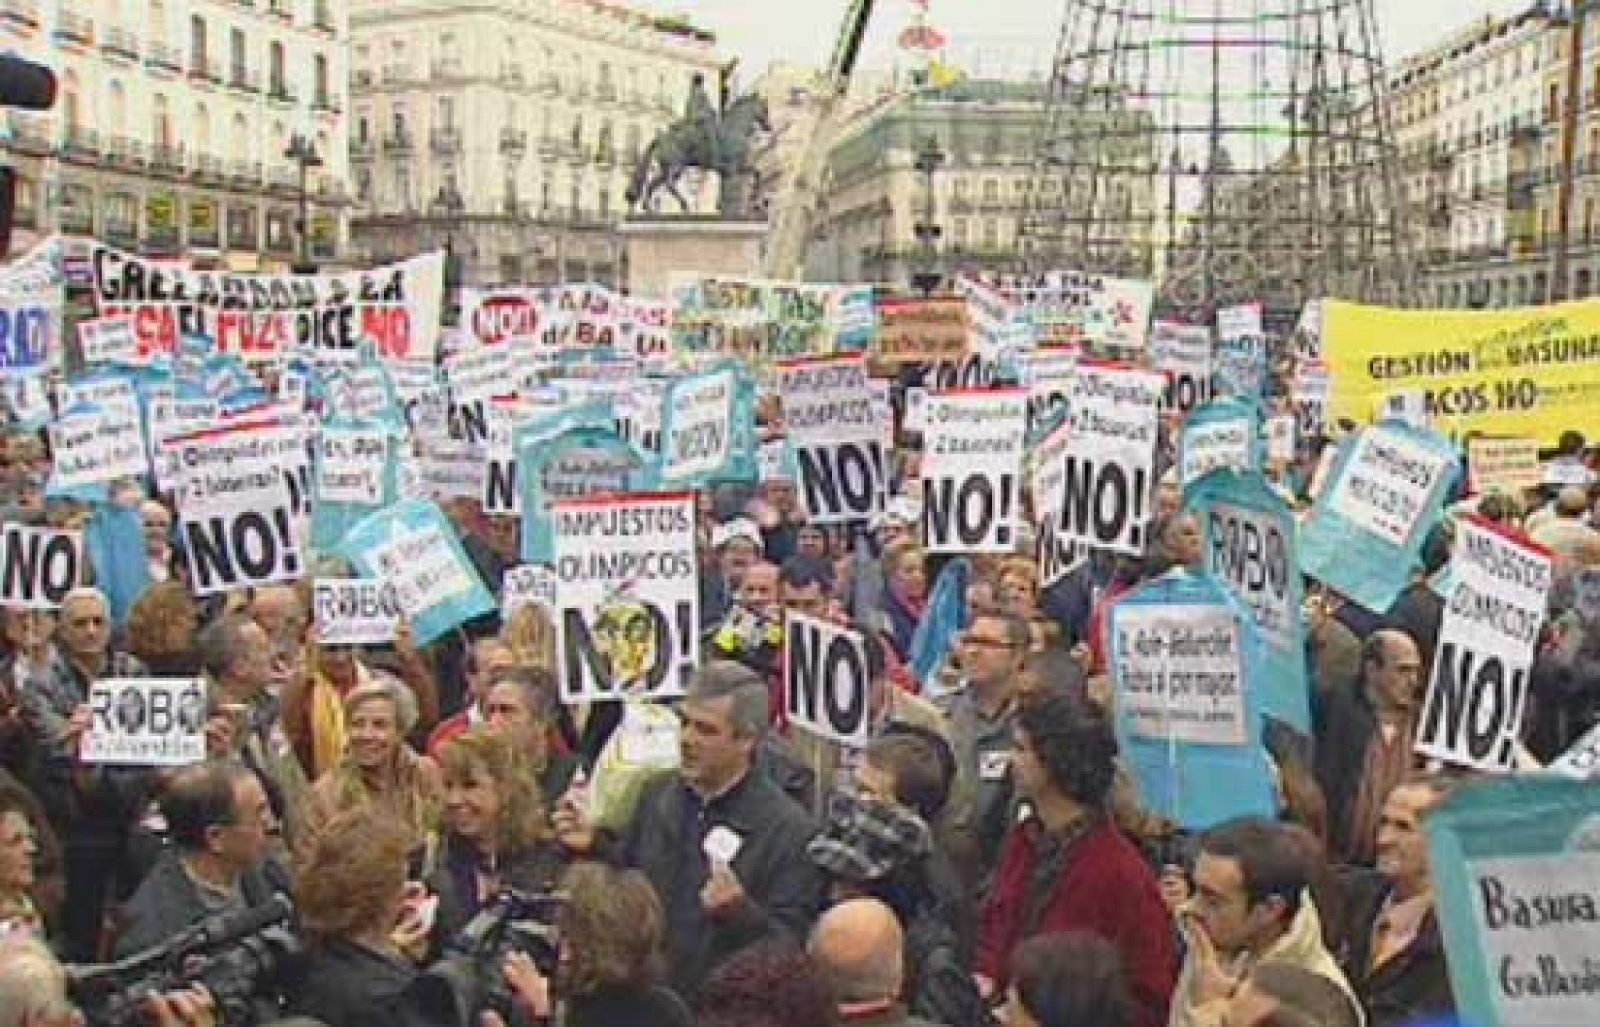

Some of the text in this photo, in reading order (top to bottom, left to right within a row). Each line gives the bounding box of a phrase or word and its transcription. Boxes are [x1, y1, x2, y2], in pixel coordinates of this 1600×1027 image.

[295, 304, 354, 350] DICE
[362, 306, 411, 361] NO
[1368, 350, 1471, 380] GESTIÓN
[800, 442, 887, 515] NO!
[922, 472, 1012, 547] NO!
[1061, 456, 1146, 548] NO!
[186, 506, 300, 591] NO!
[557, 506, 690, 536] IMPUESTOS
[3, 530, 78, 601] NO
[557, 551, 692, 583] OLIMPICOS
[562, 600, 694, 695] NO!
[788, 620, 866, 736] NO
[1422, 642, 1522, 768] NO!
[1478, 875, 1597, 930] Basura
